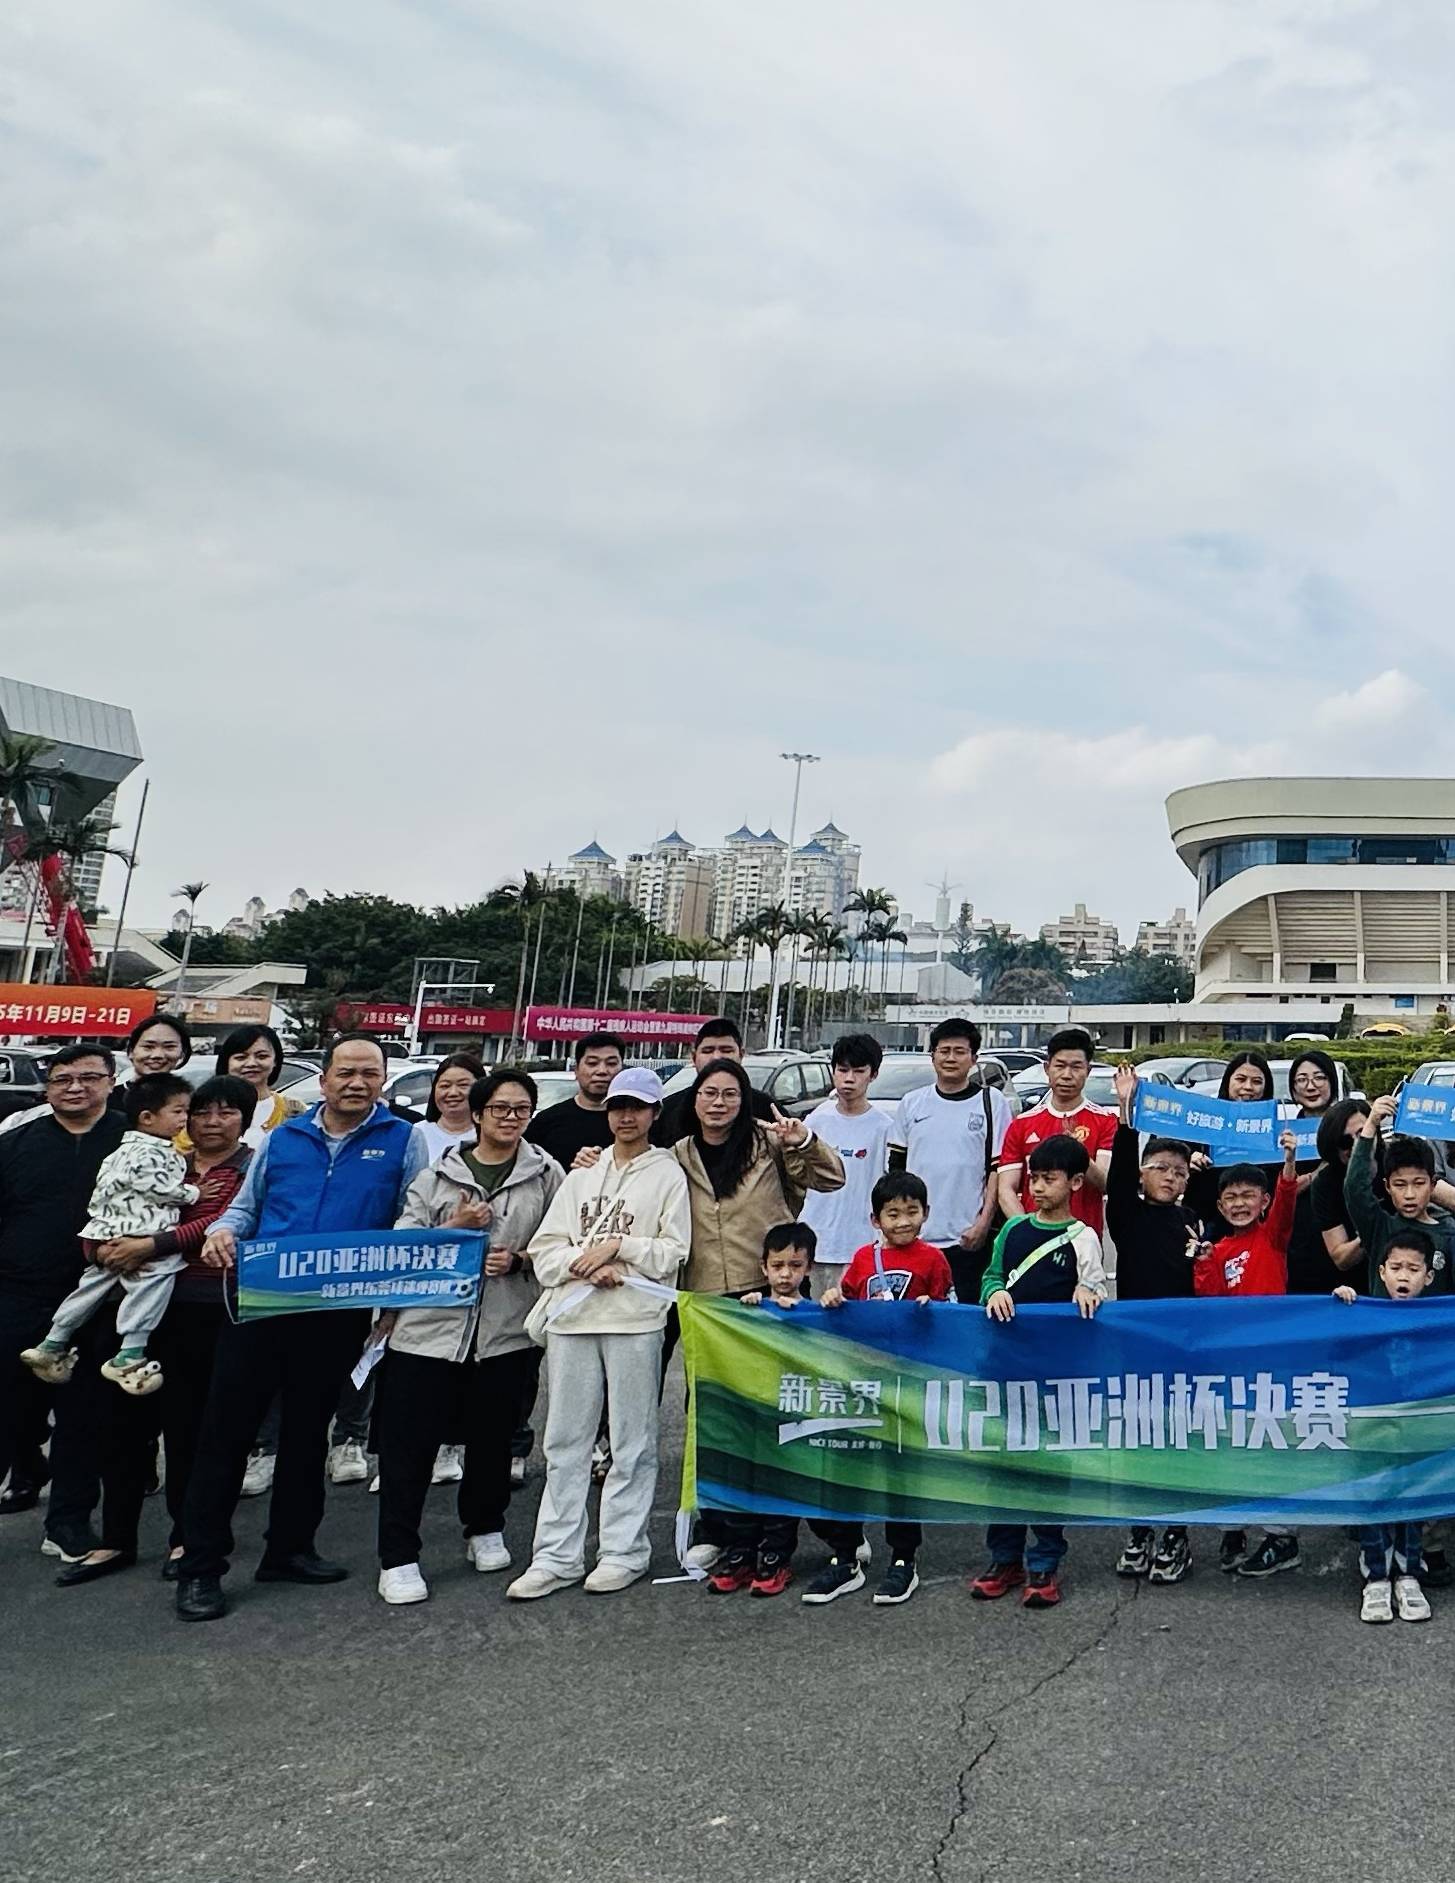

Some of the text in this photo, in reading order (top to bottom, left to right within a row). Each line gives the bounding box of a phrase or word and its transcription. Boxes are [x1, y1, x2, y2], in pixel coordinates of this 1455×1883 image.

[278, 1244, 461, 1279] U20亚洲杯决赛
[778, 1373, 882, 1415] 新景界
